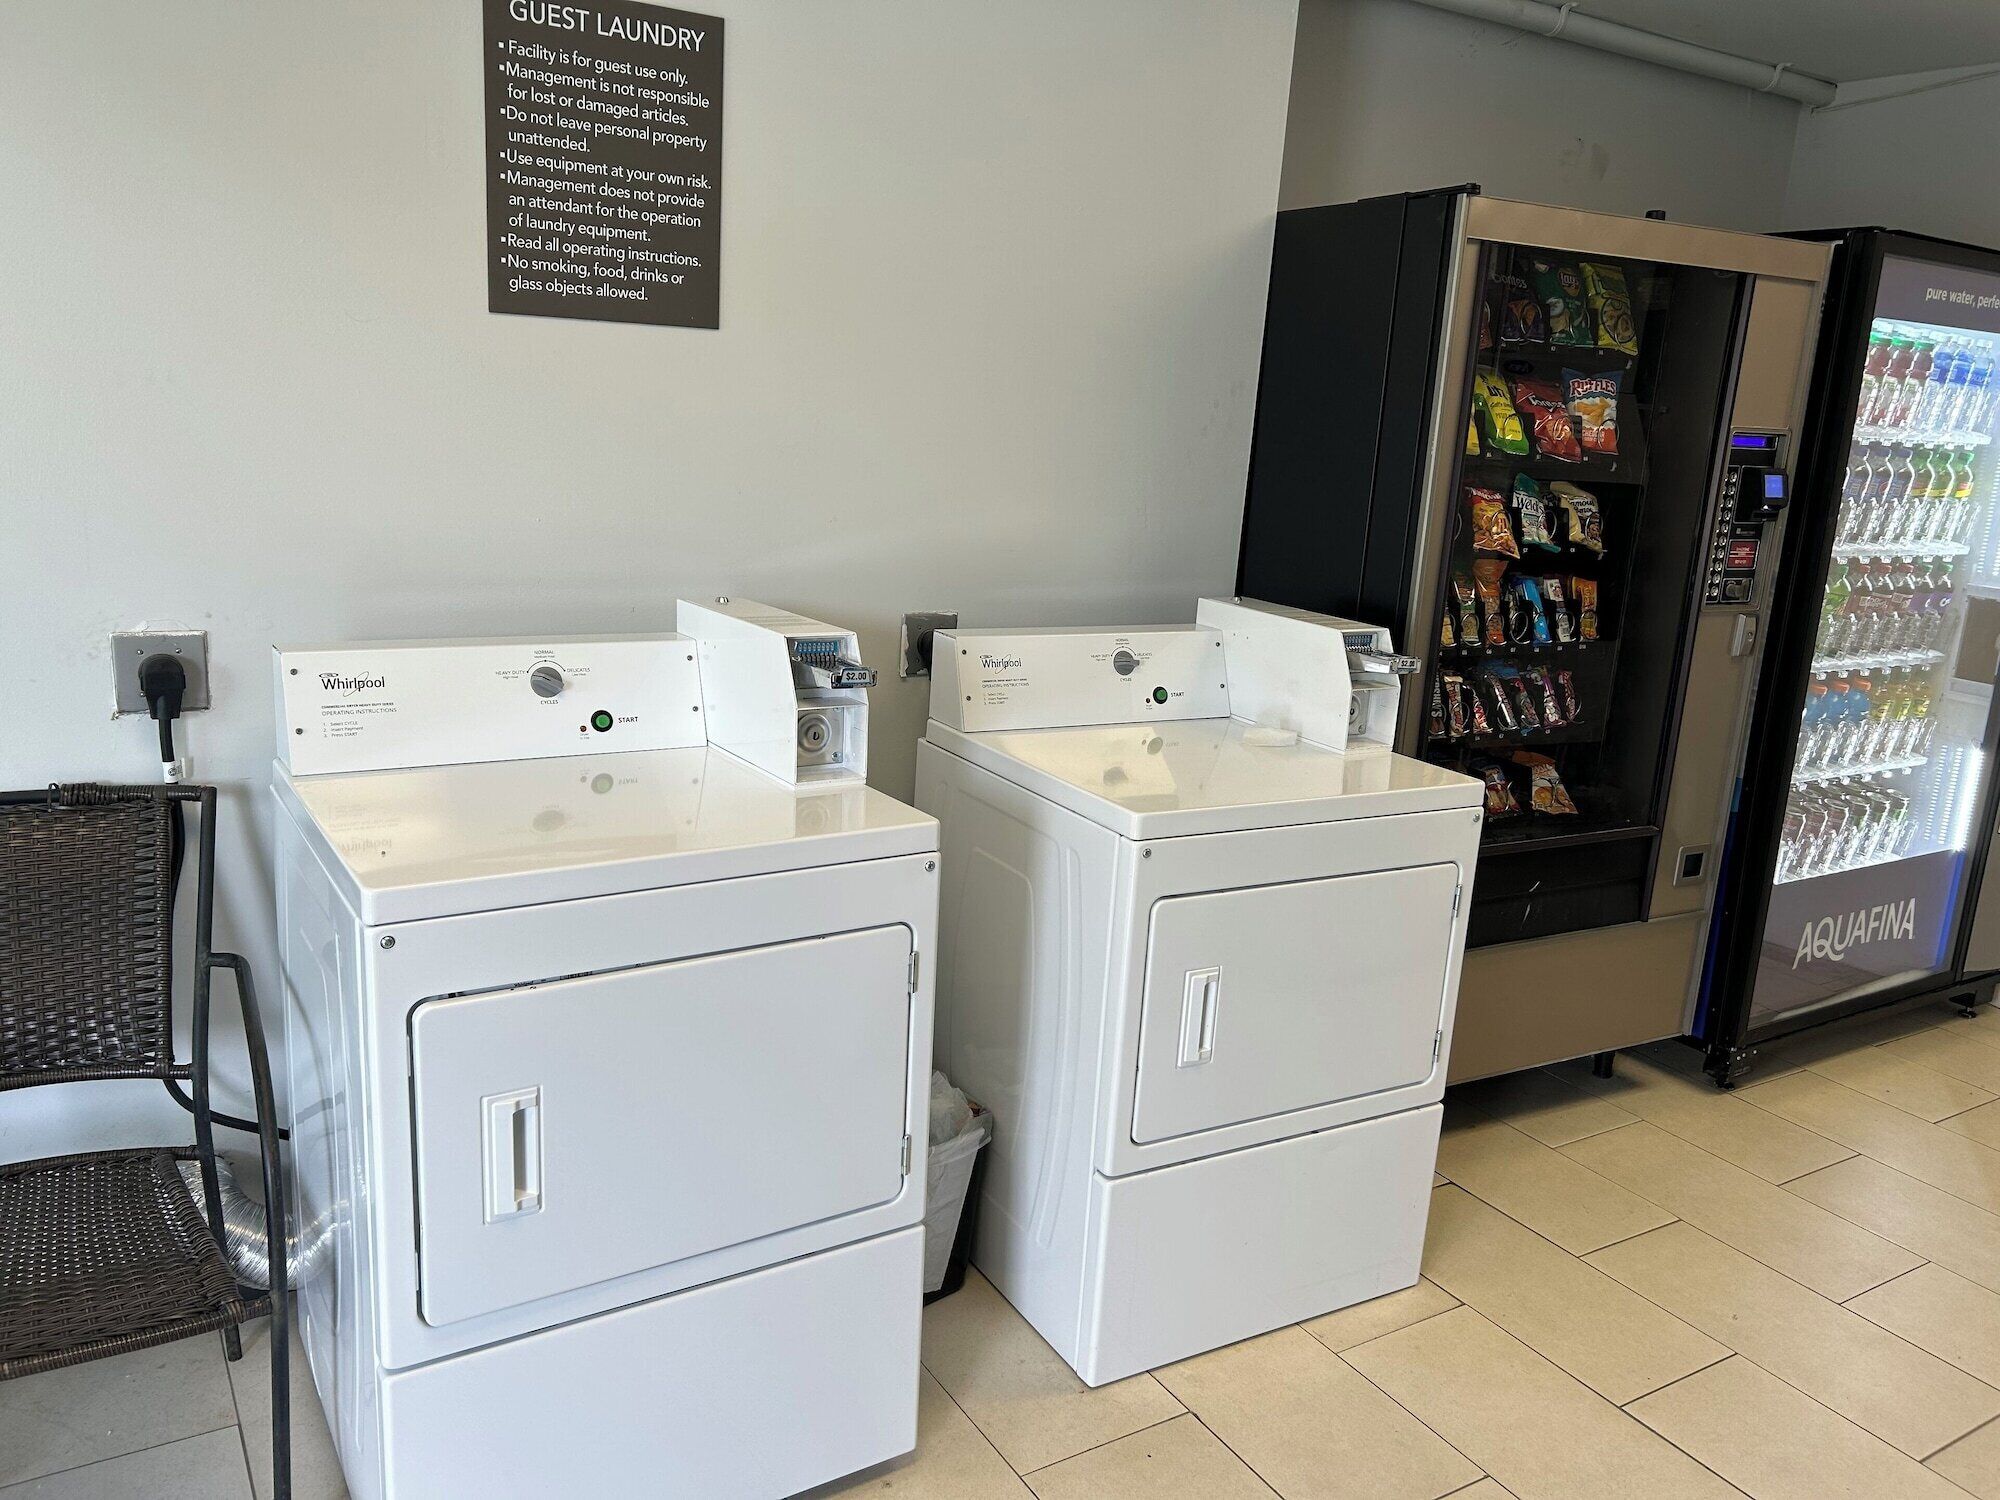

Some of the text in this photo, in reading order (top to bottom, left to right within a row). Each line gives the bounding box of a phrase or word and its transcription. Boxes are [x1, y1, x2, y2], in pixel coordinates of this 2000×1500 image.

[509, 0, 705, 52] GUEST LAUNDRY
[508, 40, 688, 87] Facility is for guest use only.
[506, 61, 710, 109] Management is not responsible
[507, 83, 689, 127] for lost or damaged articles.
[506, 105, 707, 152] Do not leave personal property
[508, 129, 591, 153] unattended.
[506, 148, 712, 189] Use equipment at your own risk.
[507, 170, 705, 209] Management does not provide
[508, 194, 701, 228] an attendant for the operation
[508, 213, 651, 243] of laundry equipment.
[507, 233, 702, 268] Read all operating instructions.
[507, 254, 684, 285] No smoking, food, drinks or
[509, 274, 649, 301] glass objects allowed.
[1925, 286, 2000, 309] pure water, perfe
[1569, 377, 1617, 397] RUFFLES
[846, 672, 867, 681] $2.00
[981, 657, 1022, 670] Whirlpool
[321, 676, 385, 692] Whirlpool
[618, 716, 639, 724] START
[1791, 897, 1916, 970] AQUAFINA
